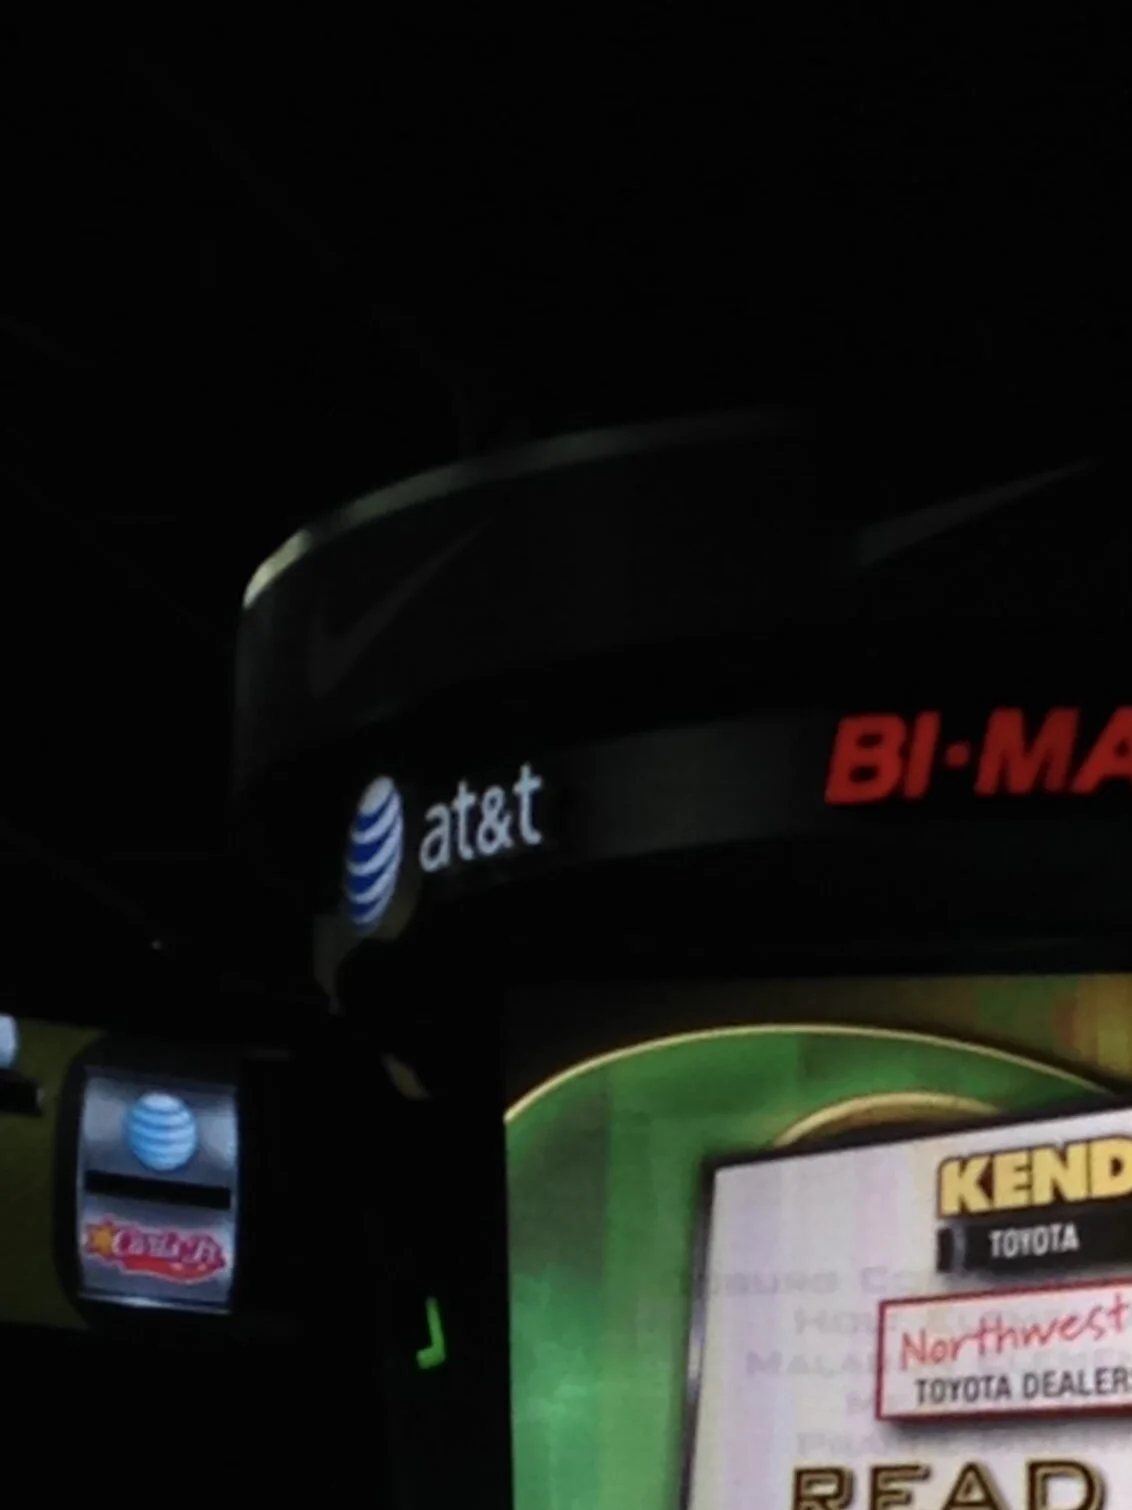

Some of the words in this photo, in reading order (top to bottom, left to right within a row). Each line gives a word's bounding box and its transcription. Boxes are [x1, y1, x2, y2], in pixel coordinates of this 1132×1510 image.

[419, 765, 542, 872] at&t
[990, 1223, 1080, 1259] TOYOTA
[901, 1293, 1132, 1369] Northwest
[915, 1372, 1011, 1406] TOYOTA
